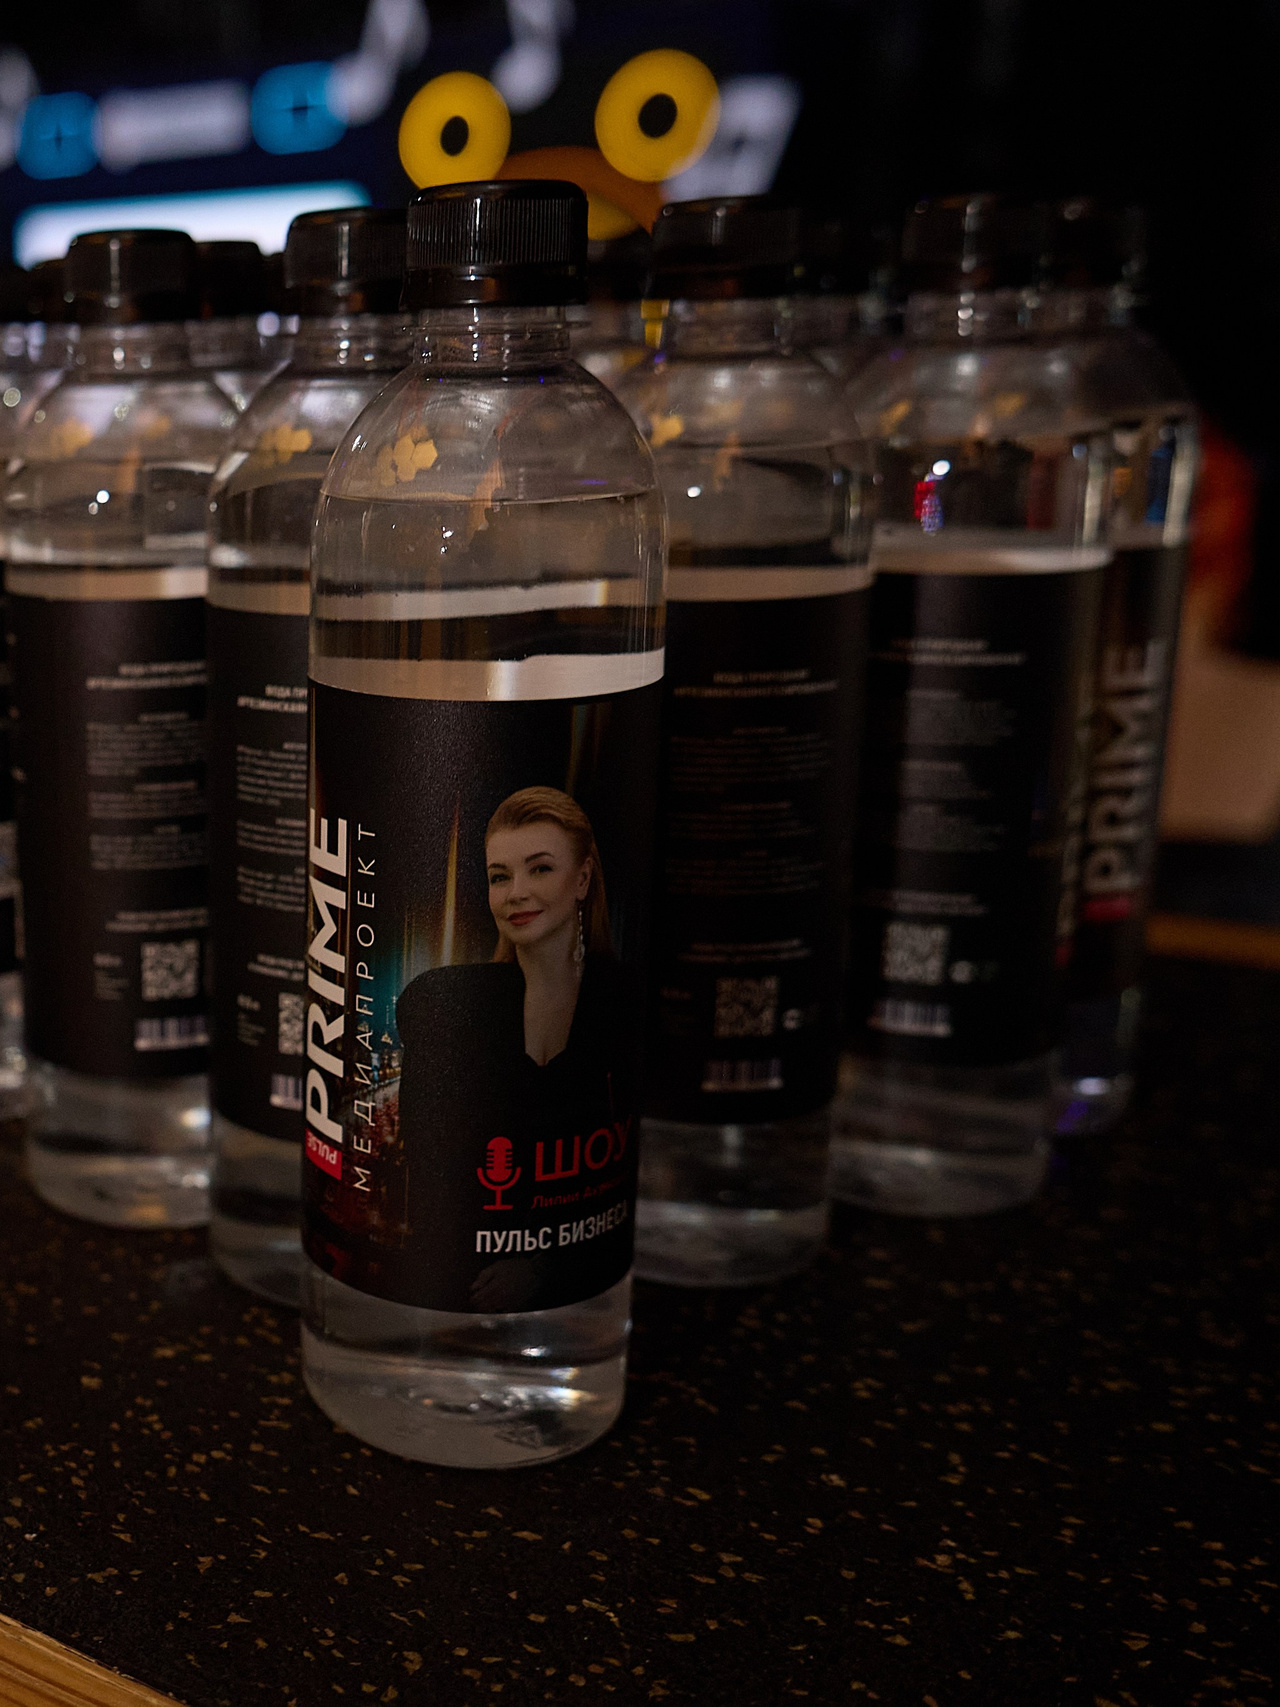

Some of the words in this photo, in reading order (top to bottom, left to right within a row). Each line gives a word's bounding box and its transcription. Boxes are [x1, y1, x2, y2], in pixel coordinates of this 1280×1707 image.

[305, 807, 348, 1144] PRIME
[353, 822, 377, 1192] МЕДИАПРОЕКТ
[476, 1226, 553, 1253] ПУЛЬС
[534, 1114, 634, 1182] ШОУ
